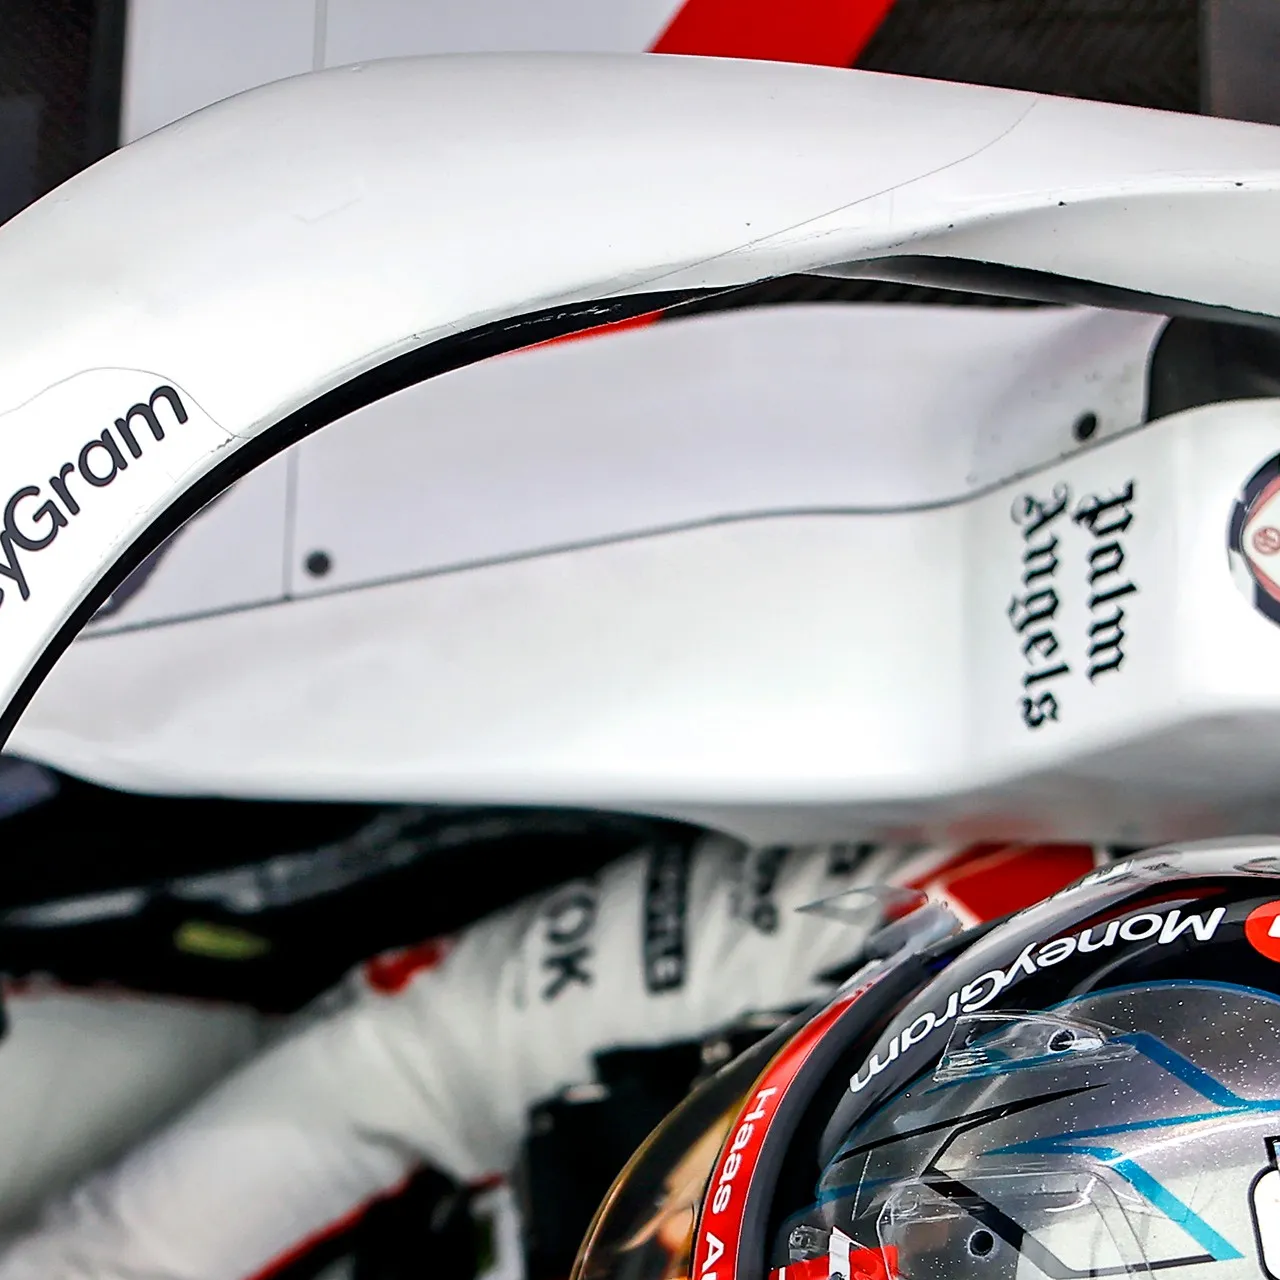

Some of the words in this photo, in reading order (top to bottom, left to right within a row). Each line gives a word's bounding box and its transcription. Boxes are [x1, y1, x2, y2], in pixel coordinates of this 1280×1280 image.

[1007, 482, 1070, 729] Angels
[1074, 478, 1135, 685] Palm
[849, 906, 1227, 1093] MoneyGram
[711, 1085, 778, 1214] Haas
